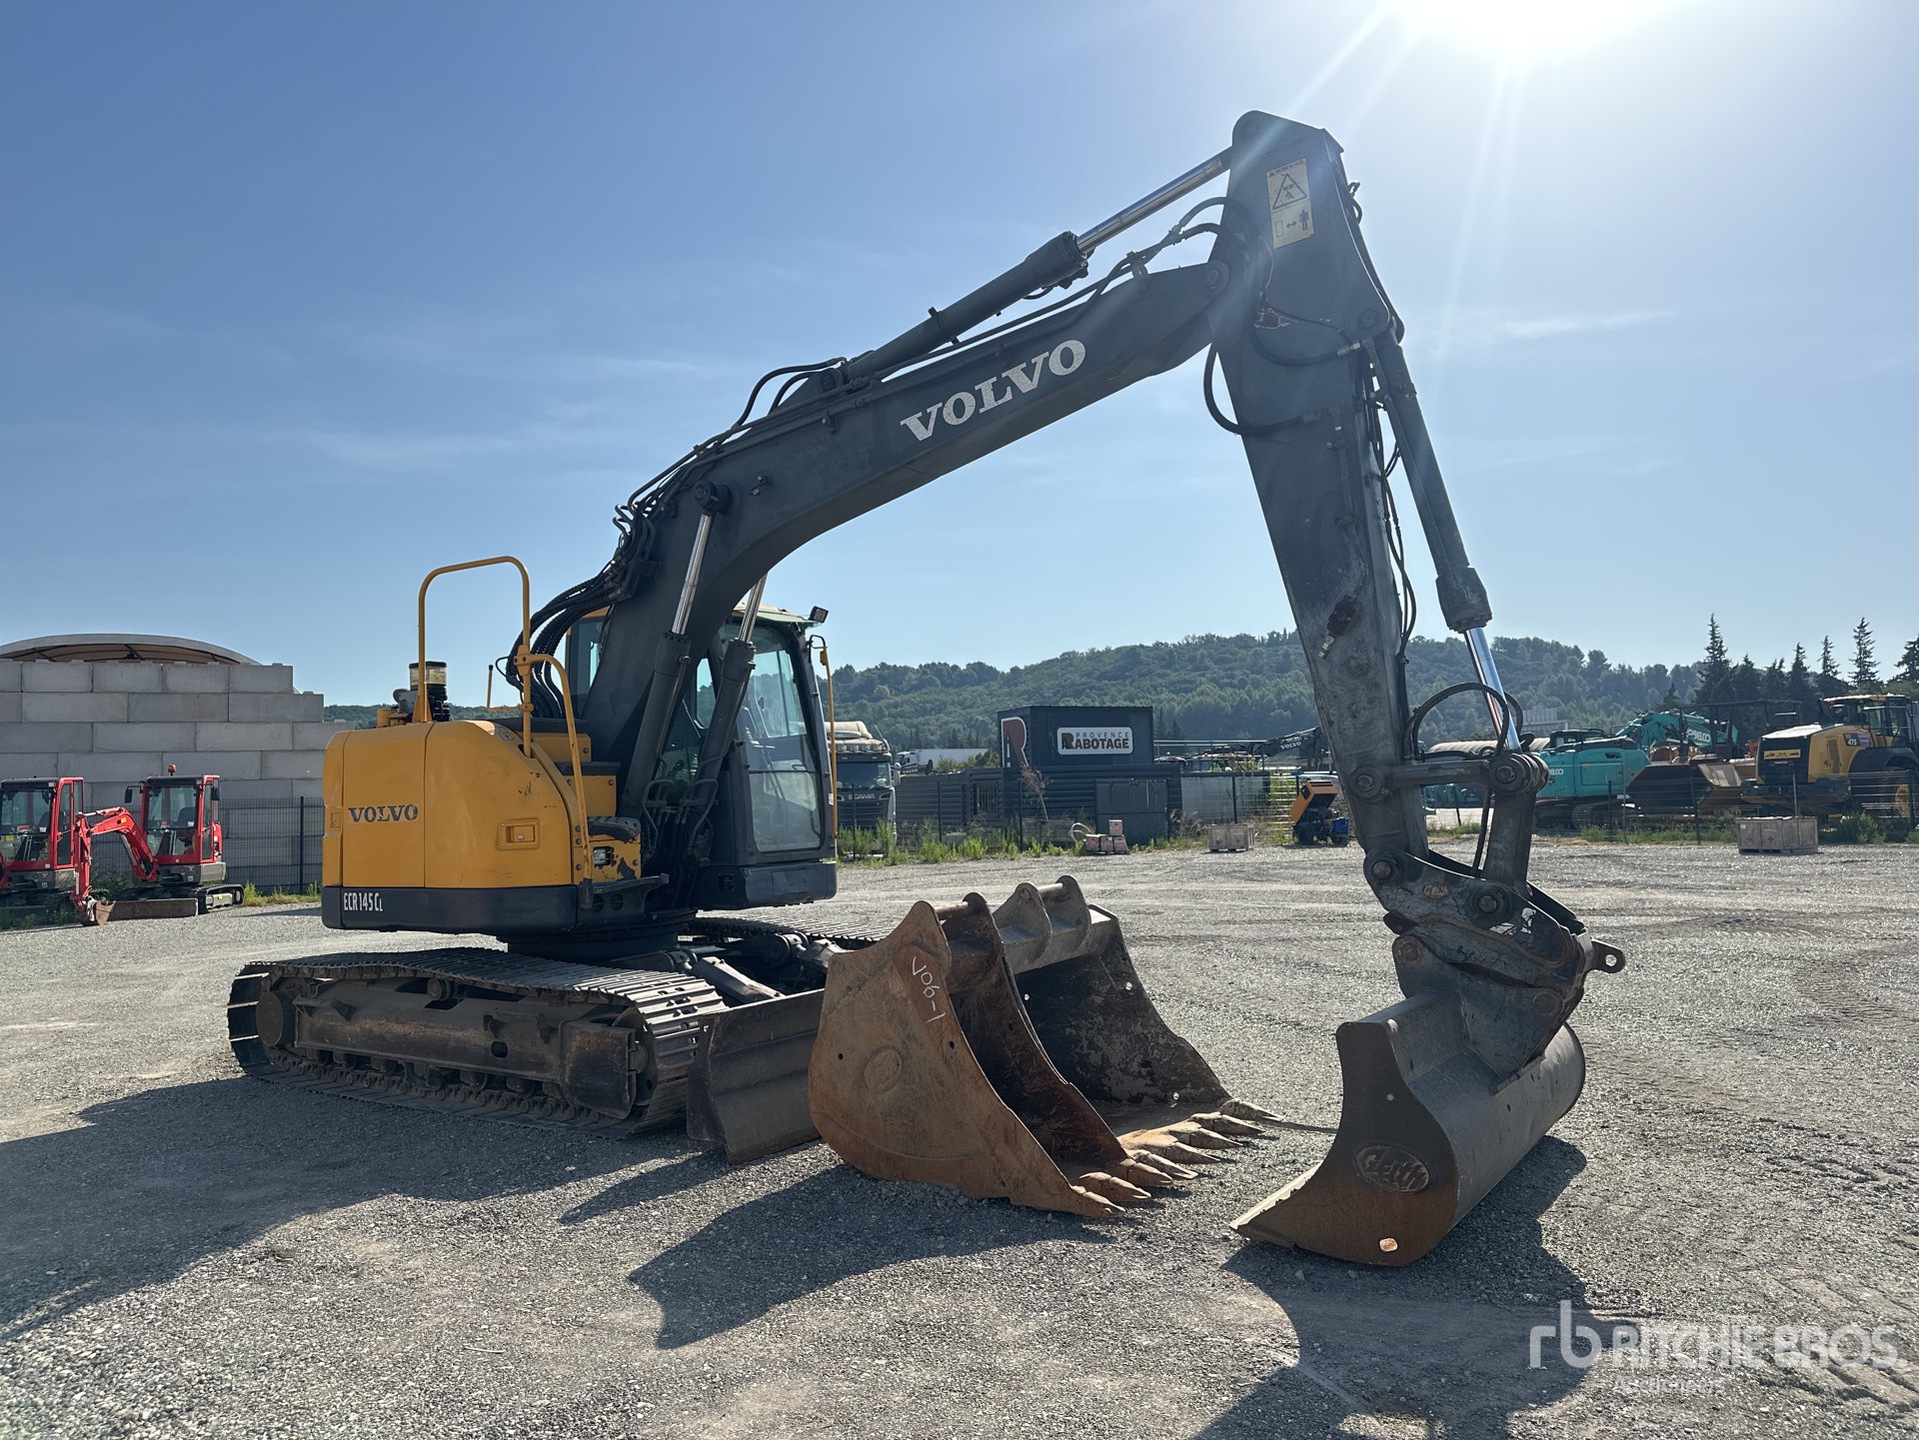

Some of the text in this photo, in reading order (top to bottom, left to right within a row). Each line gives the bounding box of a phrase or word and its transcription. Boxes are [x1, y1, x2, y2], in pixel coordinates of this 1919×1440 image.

[900, 339, 1086, 441] VOLVO
[1061, 732, 1130, 750] RABOTAGE
[1075, 731, 1129, 739] PROVENCE
[1280, 741, 1302, 750] VOLVO
[348, 803, 419, 823] VOLVO
